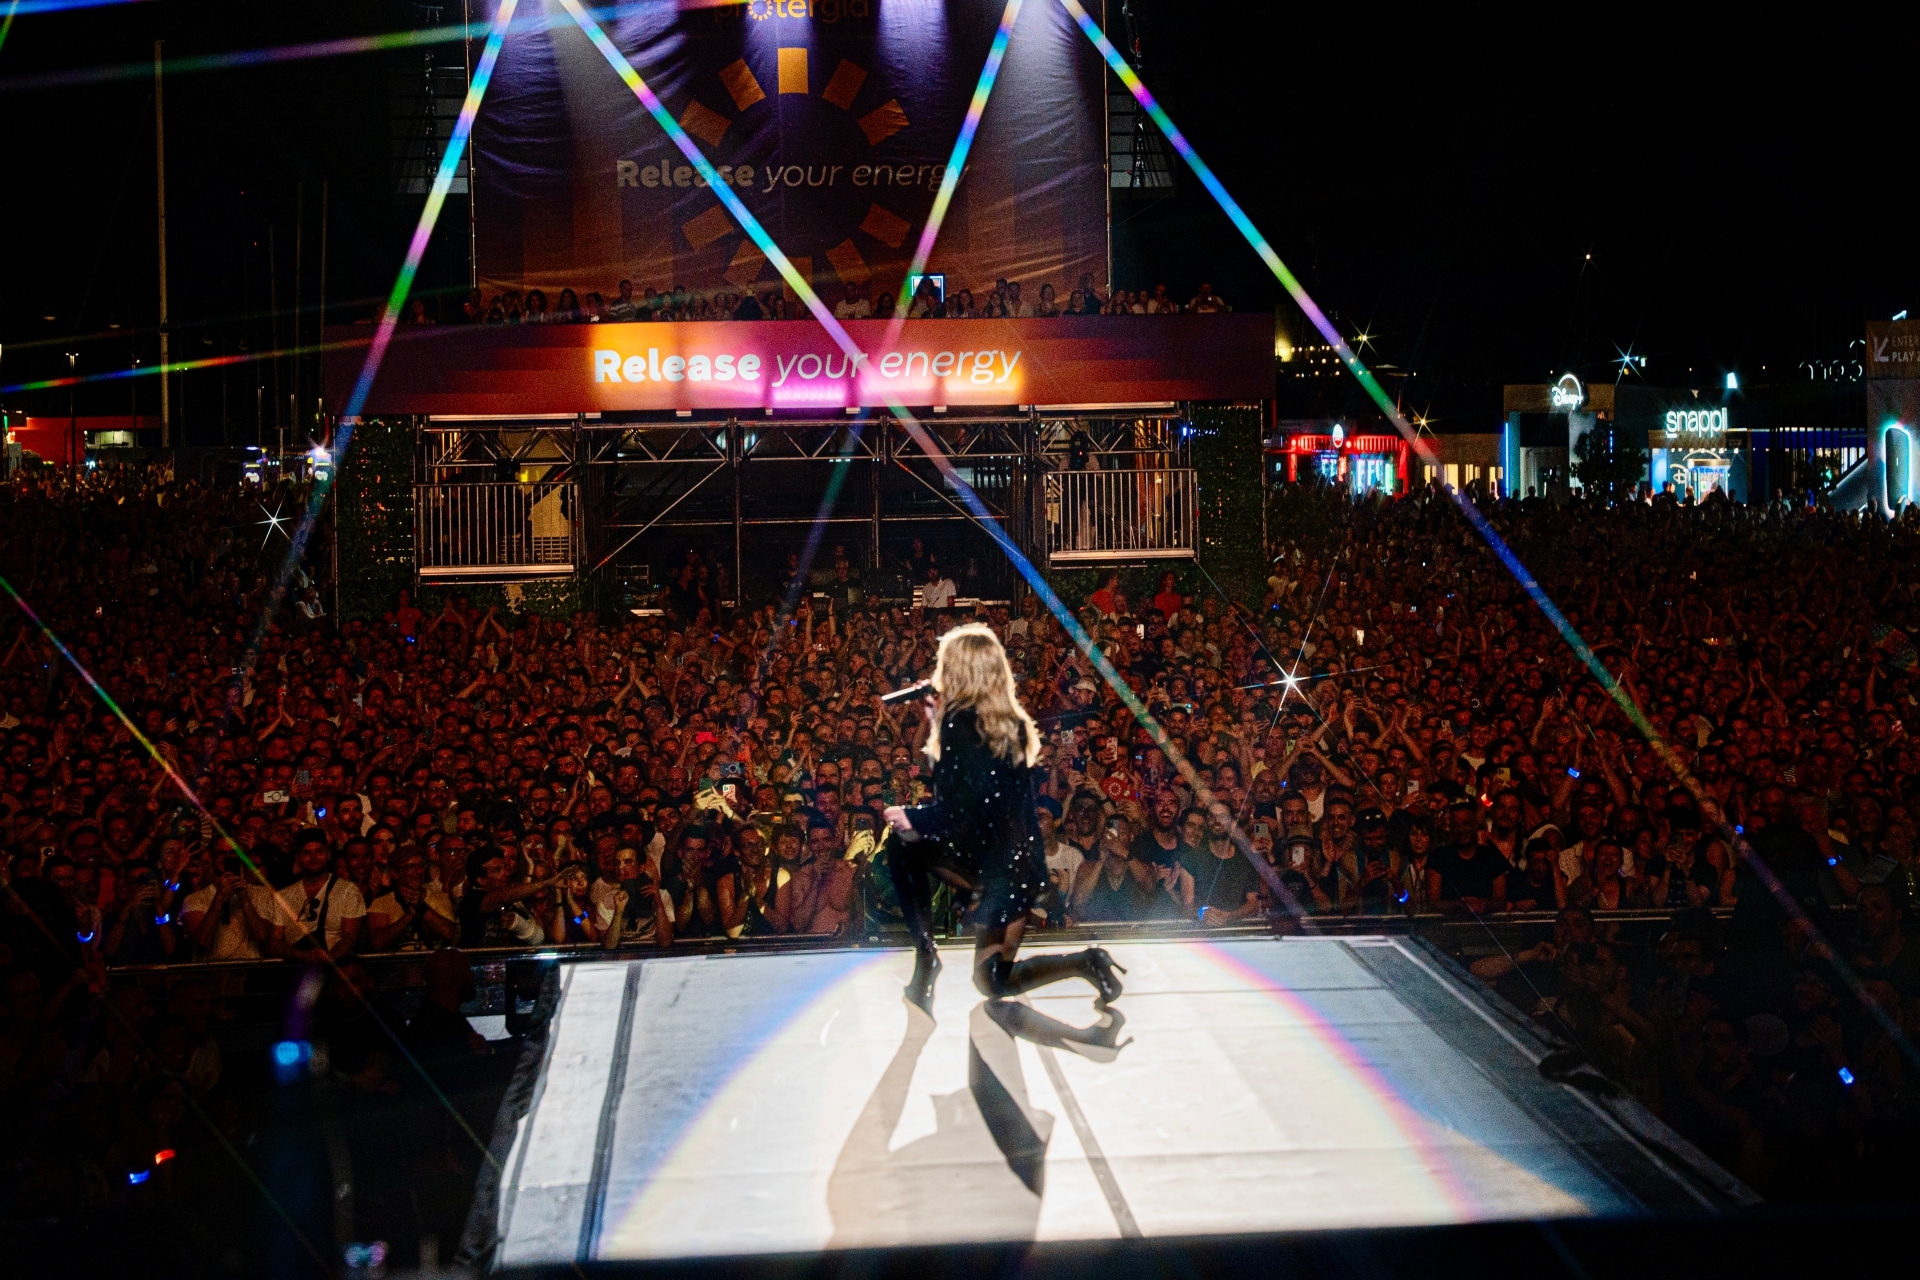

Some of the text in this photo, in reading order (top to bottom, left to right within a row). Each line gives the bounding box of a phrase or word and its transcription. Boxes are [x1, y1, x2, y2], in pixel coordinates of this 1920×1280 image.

[762, 165, 844, 193] your
[594, 348, 1022, 388] Release your energy
[1892, 351, 1915, 362] PLAY
